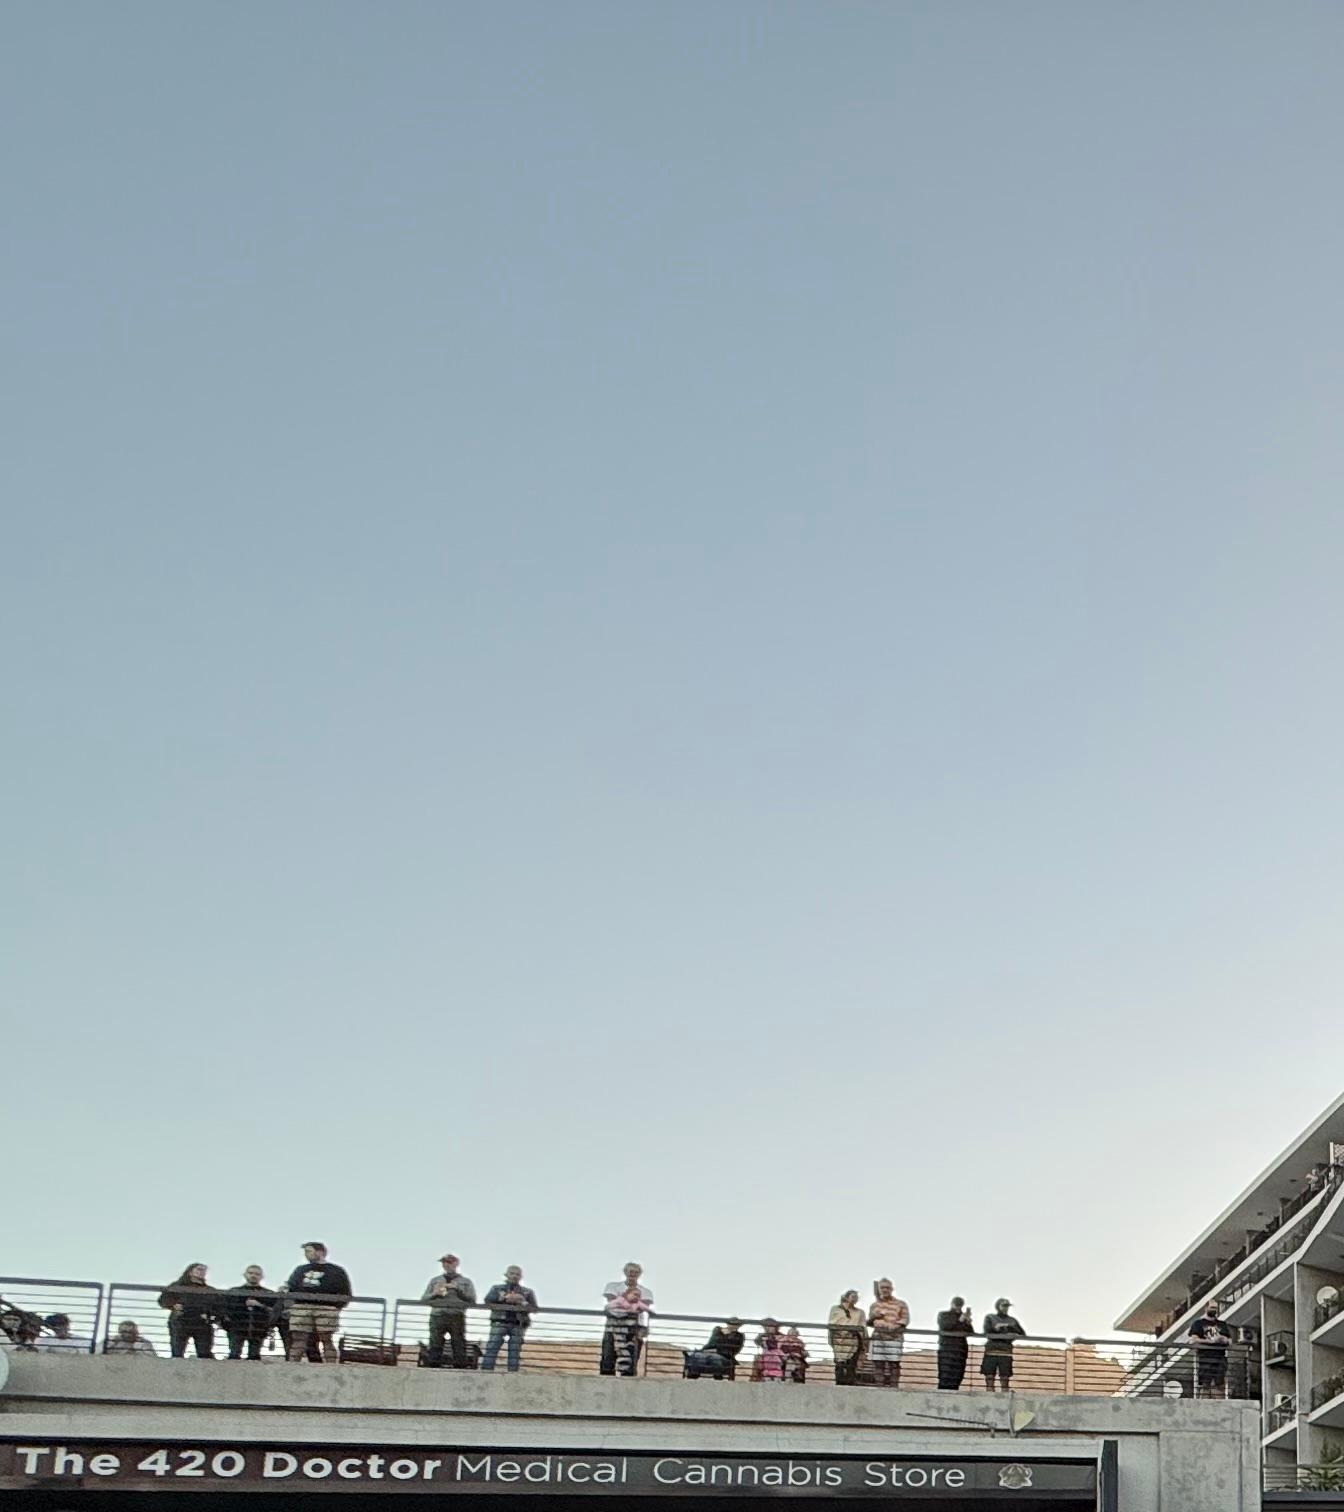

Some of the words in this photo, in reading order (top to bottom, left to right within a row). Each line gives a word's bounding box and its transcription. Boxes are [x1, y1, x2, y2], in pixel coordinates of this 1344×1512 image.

[16, 1446, 120, 1475] The
[137, 1450, 246, 1478] 420
[262, 1451, 442, 1481] Doctor
[455, 1455, 628, 1484] Medical
[652, 1457, 843, 1488] Cannabis
[864, 1461, 966, 1488] Store
